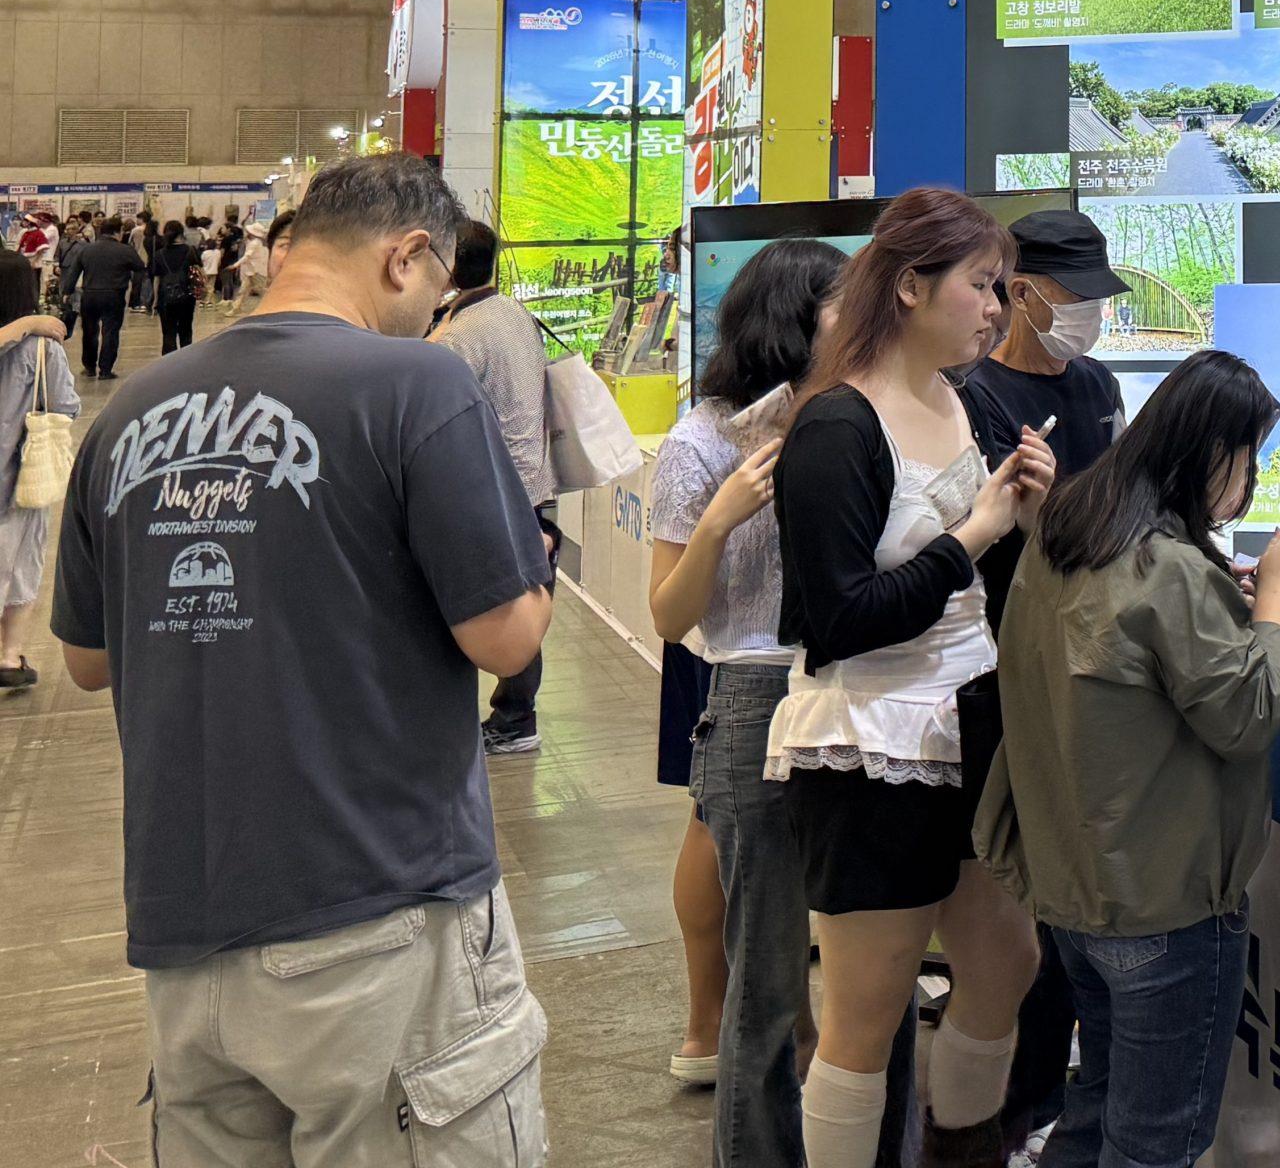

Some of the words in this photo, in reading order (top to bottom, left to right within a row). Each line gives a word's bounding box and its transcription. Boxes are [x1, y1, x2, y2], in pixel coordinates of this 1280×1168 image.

[1005, 1, 1029, 16] 고창
[587, 75, 682, 119] 정선
[539, 118, 632, 163] 민둥산
[1078, 159, 1103, 175] 전주
[543, 287, 593, 297] Jeongseon
[105, 386, 320, 517] DENVER
[153, 466, 254, 520] Nuggets
[148, 521, 212, 536] NORTHWEST
[168, 618, 189, 632] THE
